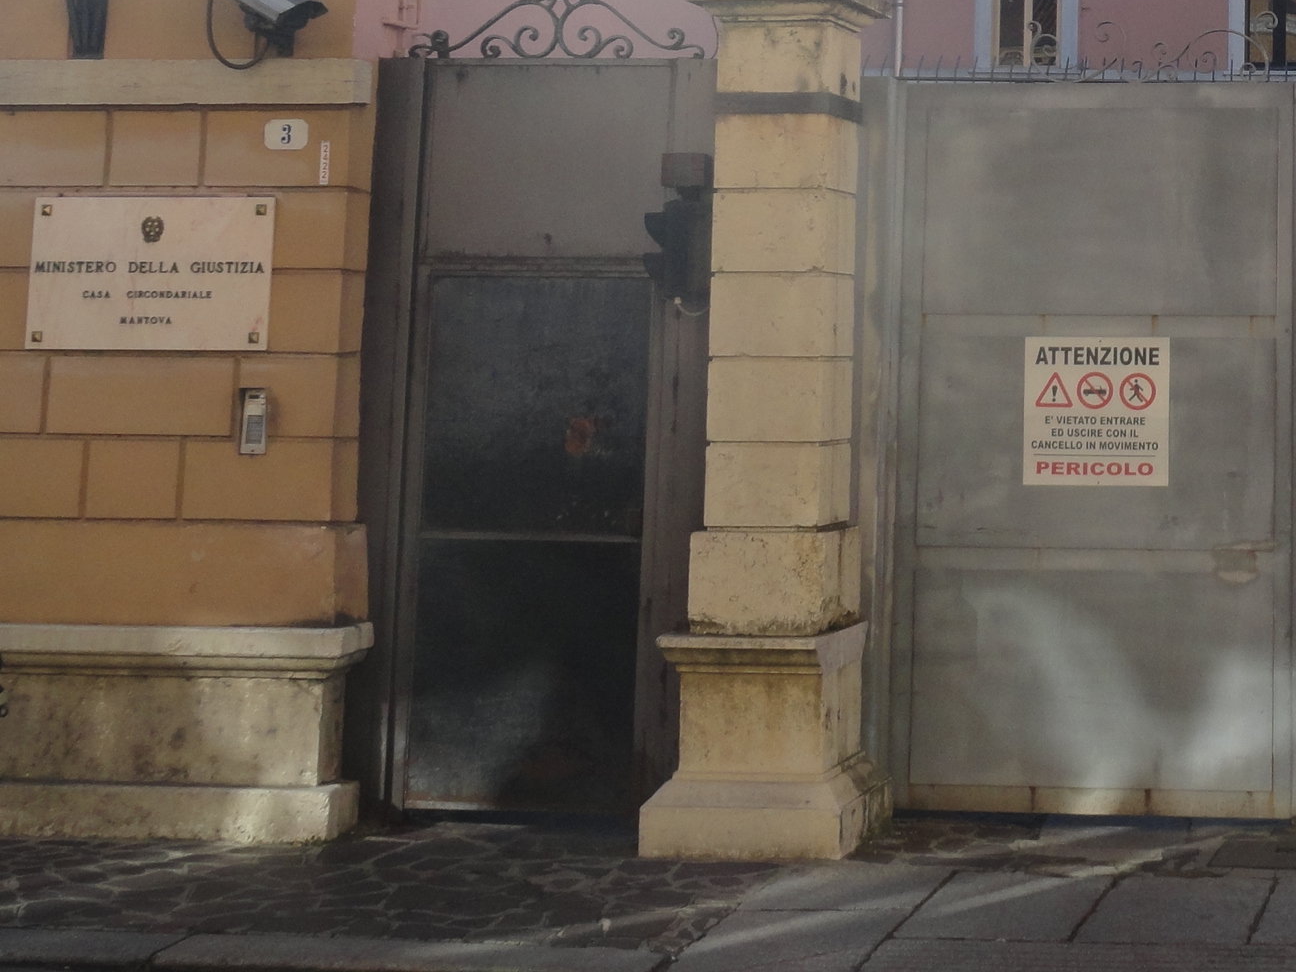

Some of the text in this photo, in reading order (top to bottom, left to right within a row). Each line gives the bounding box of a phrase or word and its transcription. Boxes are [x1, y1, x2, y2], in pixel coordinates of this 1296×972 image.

[280, 123, 292, 145] 3
[34, 260, 265, 274] MINISTERO DELLA GIUSTIZIA
[82, 290, 213, 299] CASA CIRCONDARIALE
[119, 316, 172, 325] MANTOVA
[1035, 346, 1160, 365] ATTENZIONE
[1045, 416, 1146, 426] E' VIETATO ENTRARE
[1051, 428, 1139, 438] ED USCIRE CON IL
[1031, 440, 1159, 451] CANCELLO IN MOVIMENTO
[1036, 461, 1154, 476] PERICOLO
